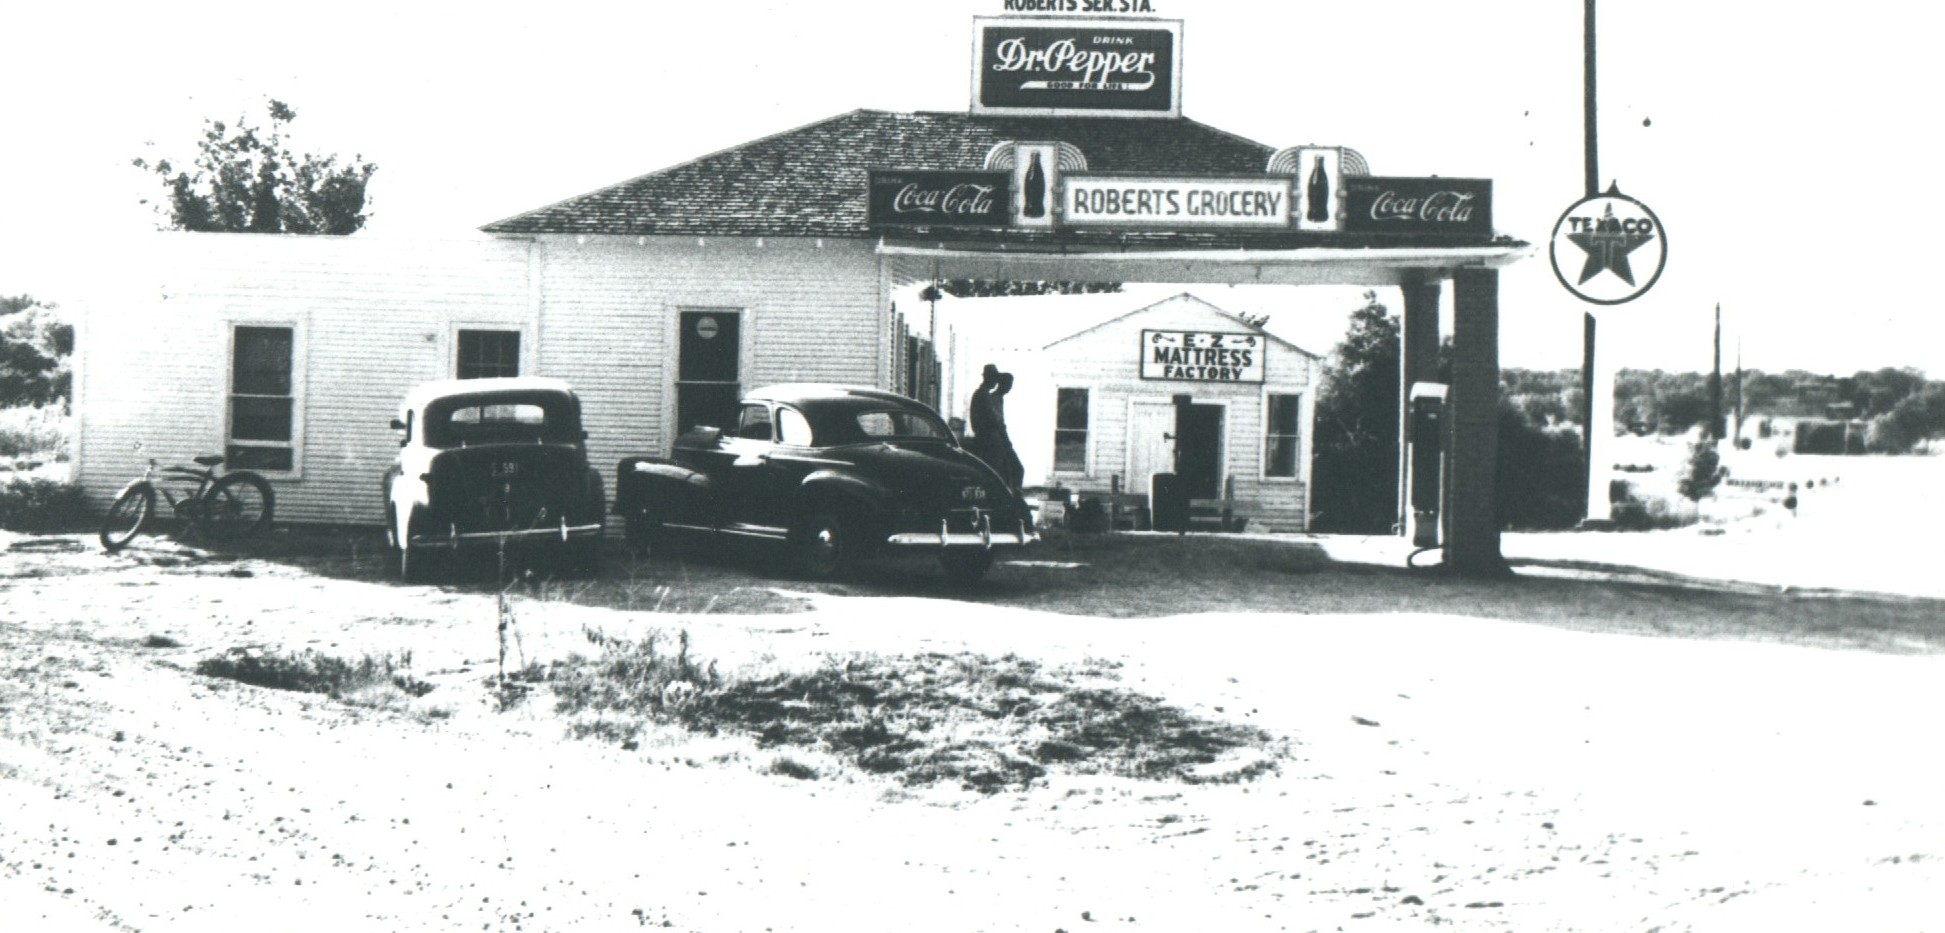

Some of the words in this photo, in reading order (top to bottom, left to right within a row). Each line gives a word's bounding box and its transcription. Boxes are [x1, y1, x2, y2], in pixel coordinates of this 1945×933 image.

[1093, 36, 1134, 45] DRINK
[1074, 188, 1180, 215] ROBERTS
[1187, 190, 1282, 216] GROCERY
[1567, 216, 1654, 234] TEXACO
[1154, 347, 1252, 367] MATTRESS
[1164, 365, 1243, 380] FACTORY
